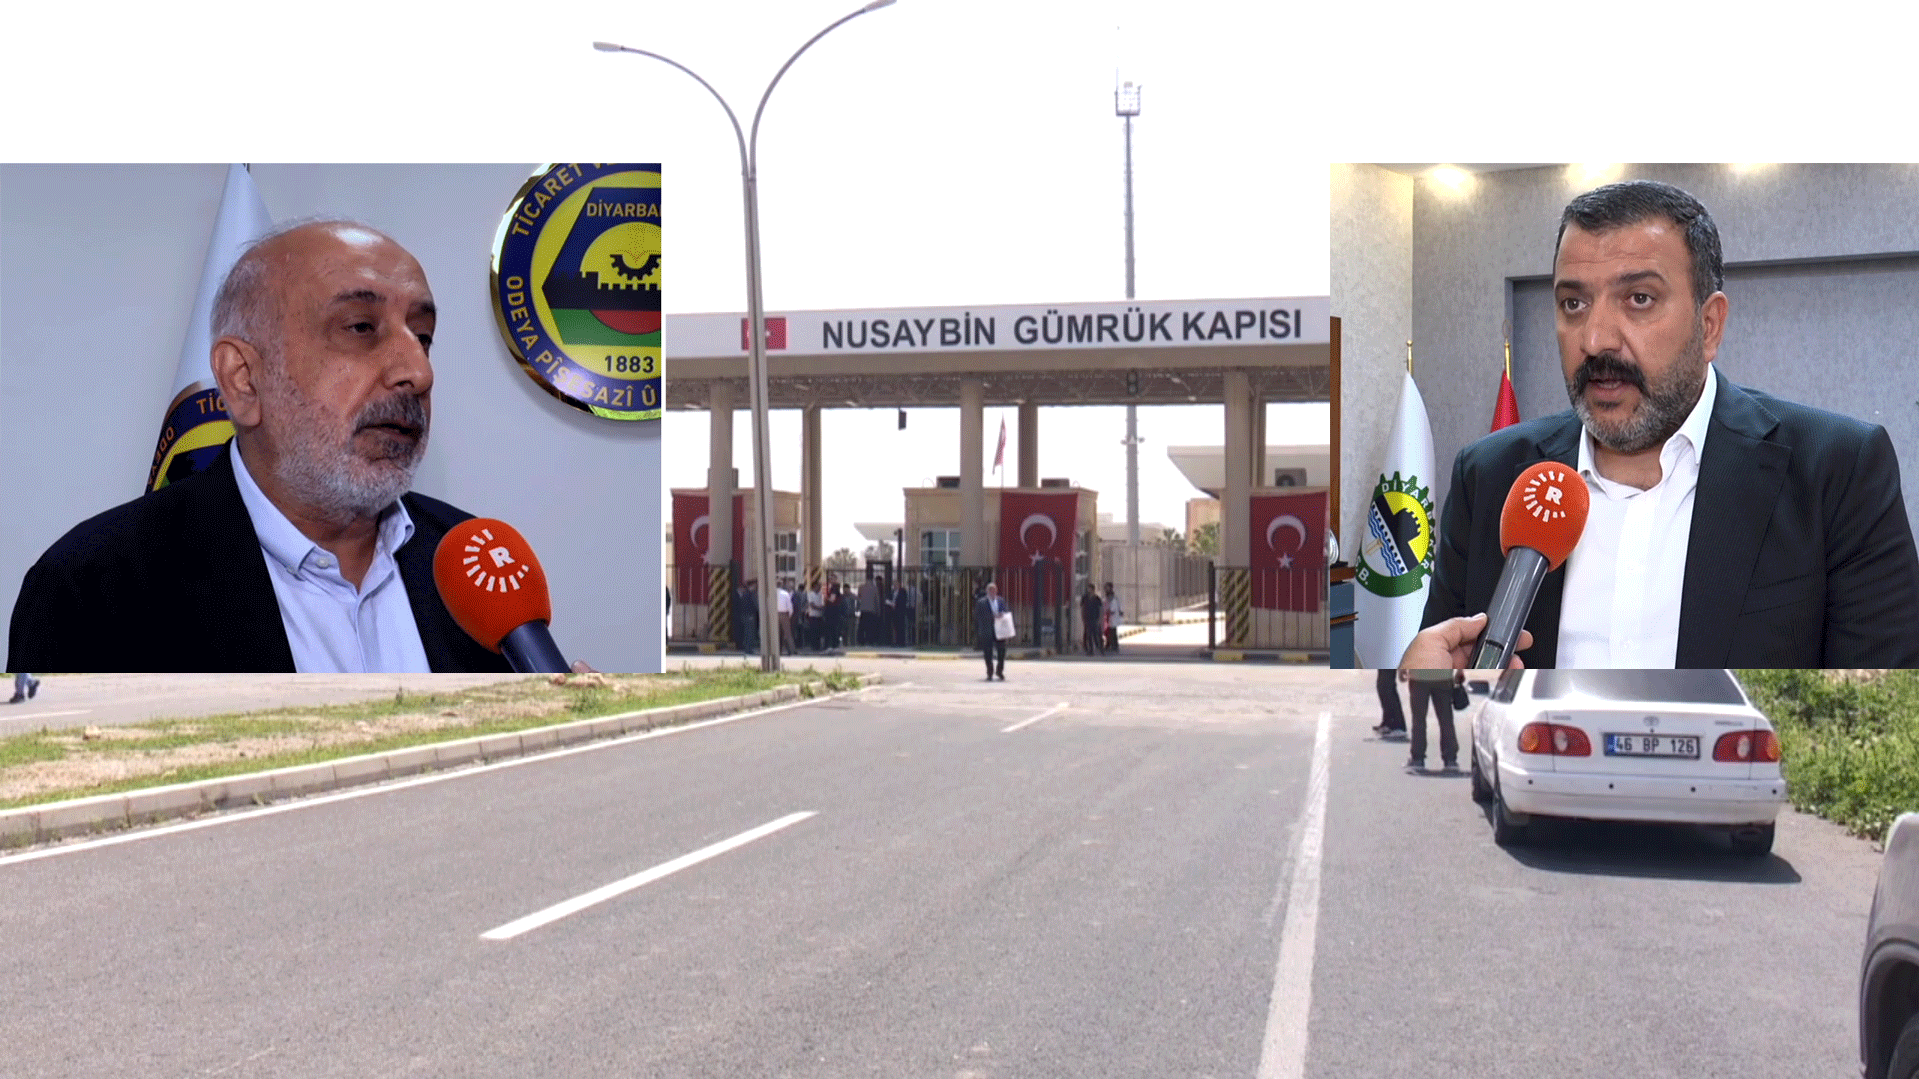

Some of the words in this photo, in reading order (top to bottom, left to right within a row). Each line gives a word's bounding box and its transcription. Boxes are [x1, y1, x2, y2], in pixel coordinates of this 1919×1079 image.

[511, 163, 583, 238] TİCARET
[587, 199, 661, 218] DİYARBA
[506, 275, 540, 350] ODEYA
[822, 310, 997, 349] NUSAYBİN
[1013, 309, 1174, 345] GÜMRÜK
[1181, 308, 1301, 342] KAPISI
[603, 354, 655, 374] 1883
[1545, 485, 1563, 506] R
[488, 546, 515, 568] R
[1642, 738, 1660, 753] BP
[1670, 738, 1695, 754] 126
